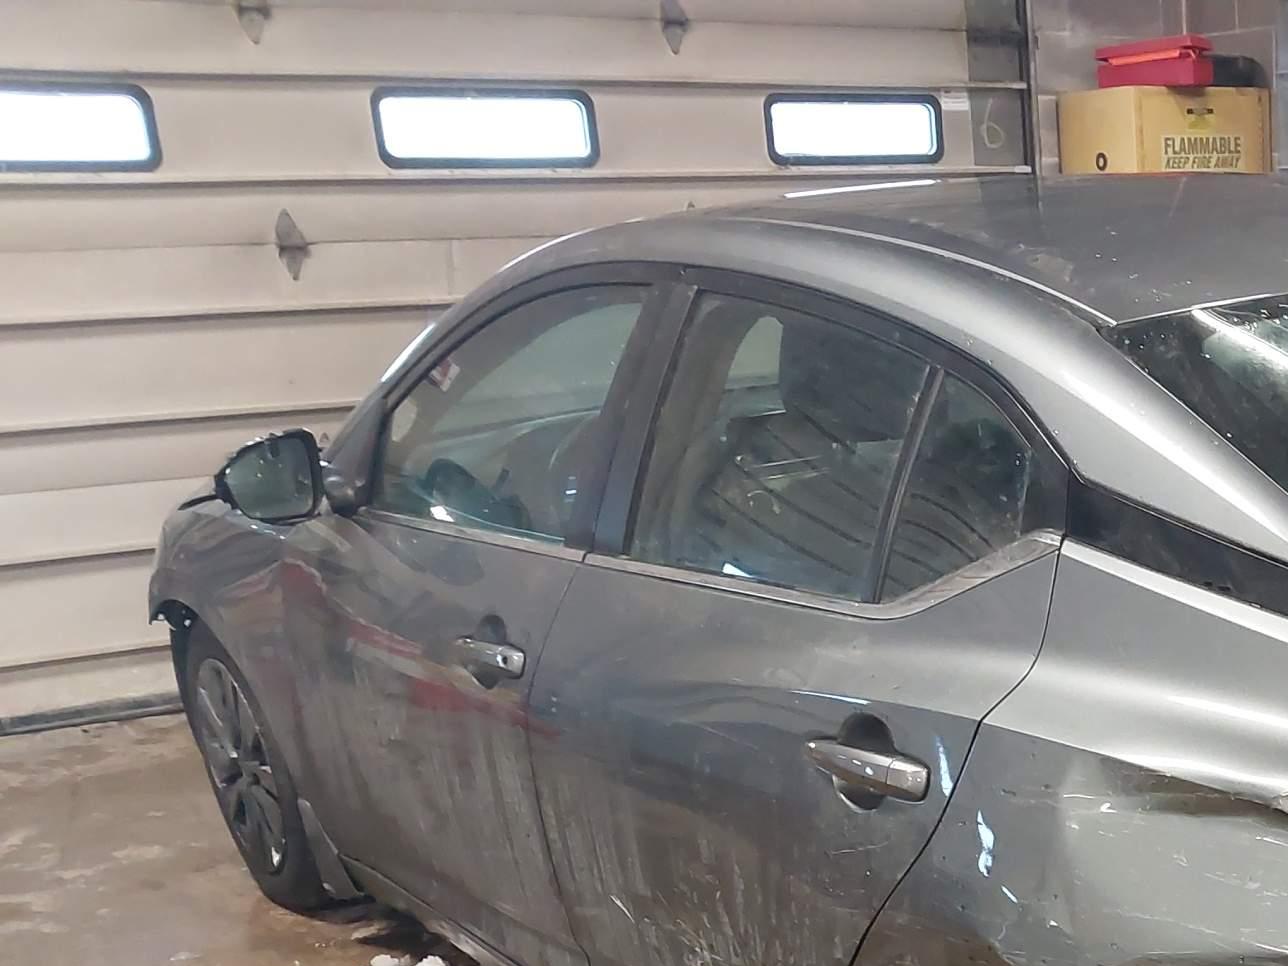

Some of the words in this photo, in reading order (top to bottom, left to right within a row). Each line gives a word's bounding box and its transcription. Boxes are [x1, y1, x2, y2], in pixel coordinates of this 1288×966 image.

[1164, 136, 1241, 155] FLAMMABLE
[1164, 155, 1190, 169] KEEP
[1191, 154, 1213, 169] FIRE
[1214, 154, 1241, 168] AWAY
